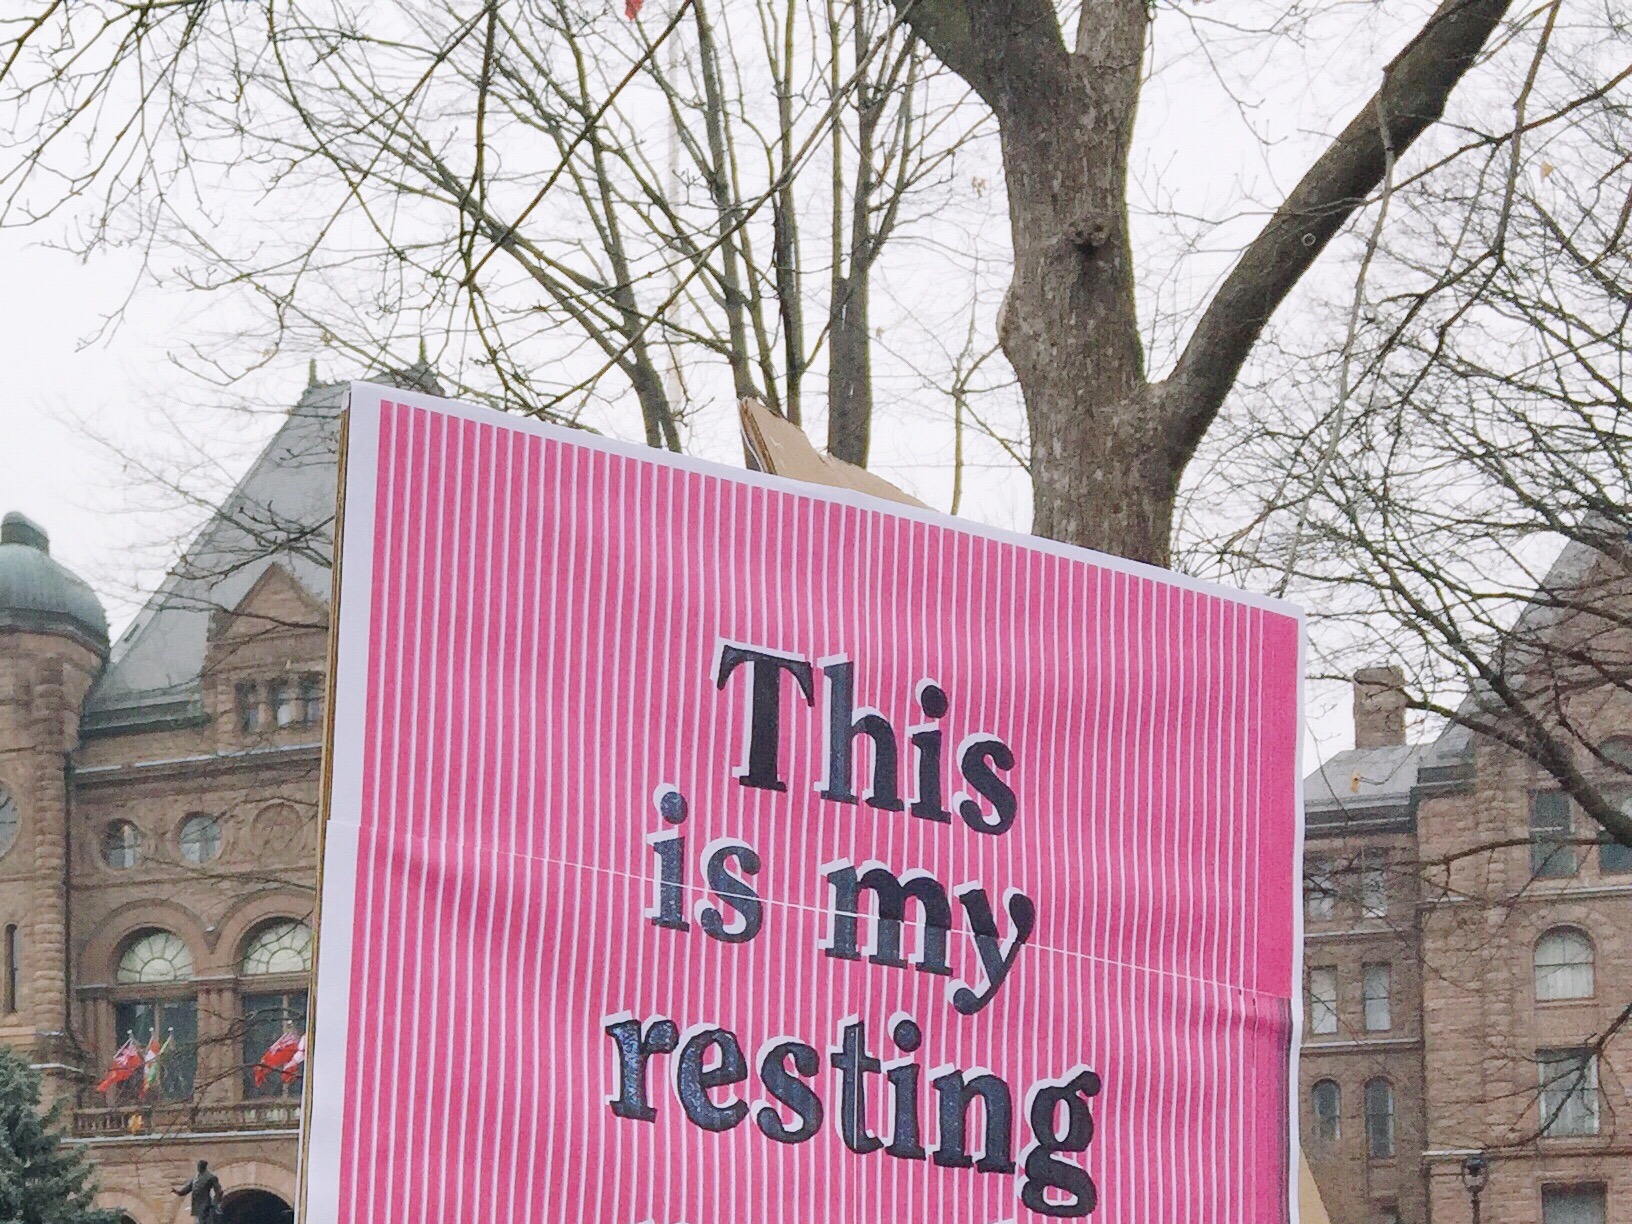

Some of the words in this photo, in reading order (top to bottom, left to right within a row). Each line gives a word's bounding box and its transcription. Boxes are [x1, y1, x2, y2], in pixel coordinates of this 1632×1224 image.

[711, 636, 1018, 837] This
[647, 786, 764, 944] is
[818, 857, 1036, 1015] my
[603, 1010, 1101, 1219] resting
